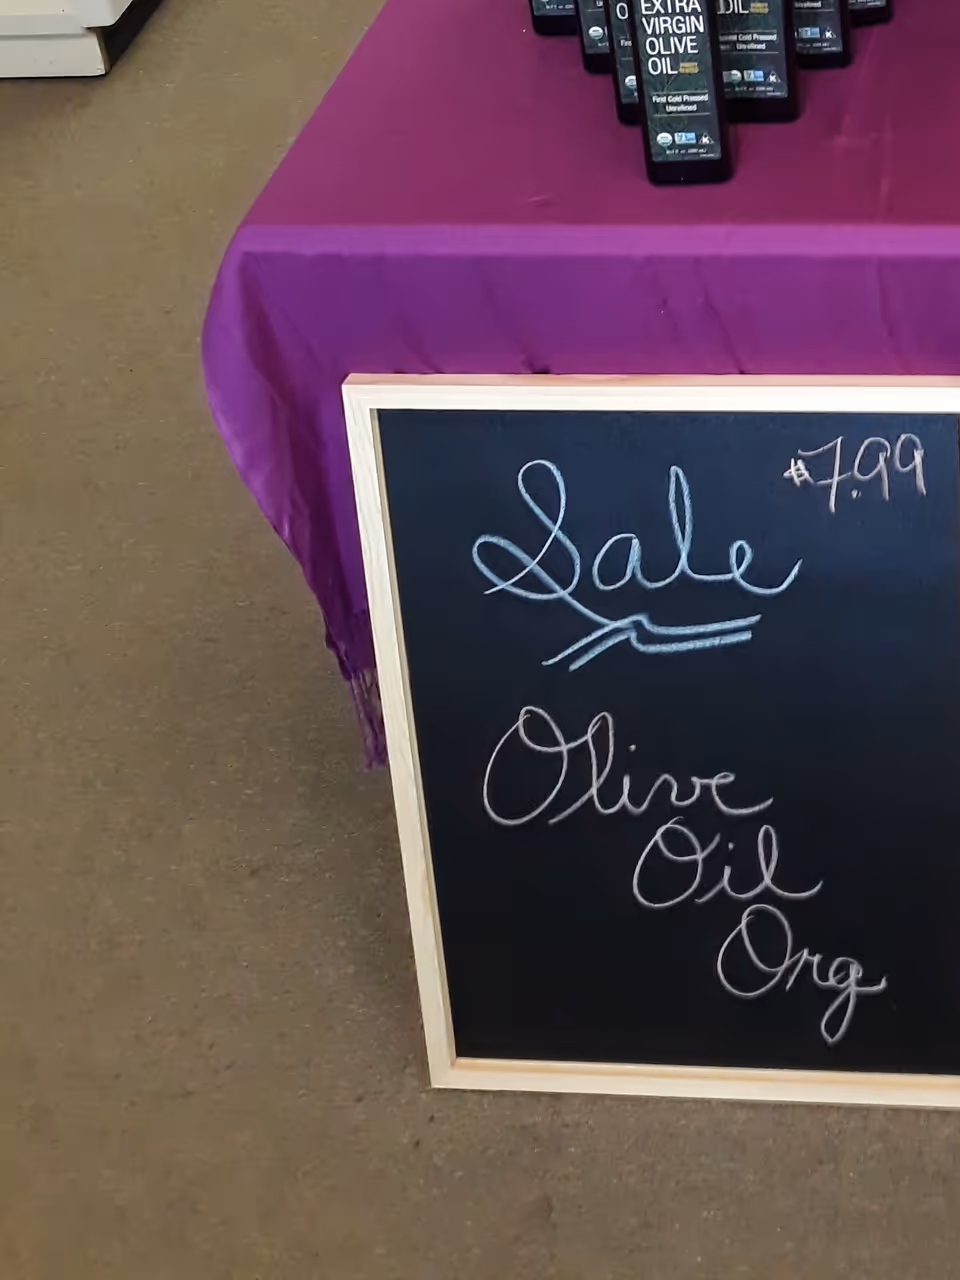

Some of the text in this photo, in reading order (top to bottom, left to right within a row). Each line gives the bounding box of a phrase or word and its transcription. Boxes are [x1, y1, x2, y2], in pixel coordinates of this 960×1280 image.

[642, 15, 704, 34] VIRGIN
[646, 36, 699, 55] OLIVE
[648, 57, 678, 75] OIL
[783, 433, 927, 513] $7.99
[472, 459, 803, 600] Sale
[484, 706, 774, 825] Olive
[633, 817, 824, 908] Oil
[717, 904, 888, 1044] Org
